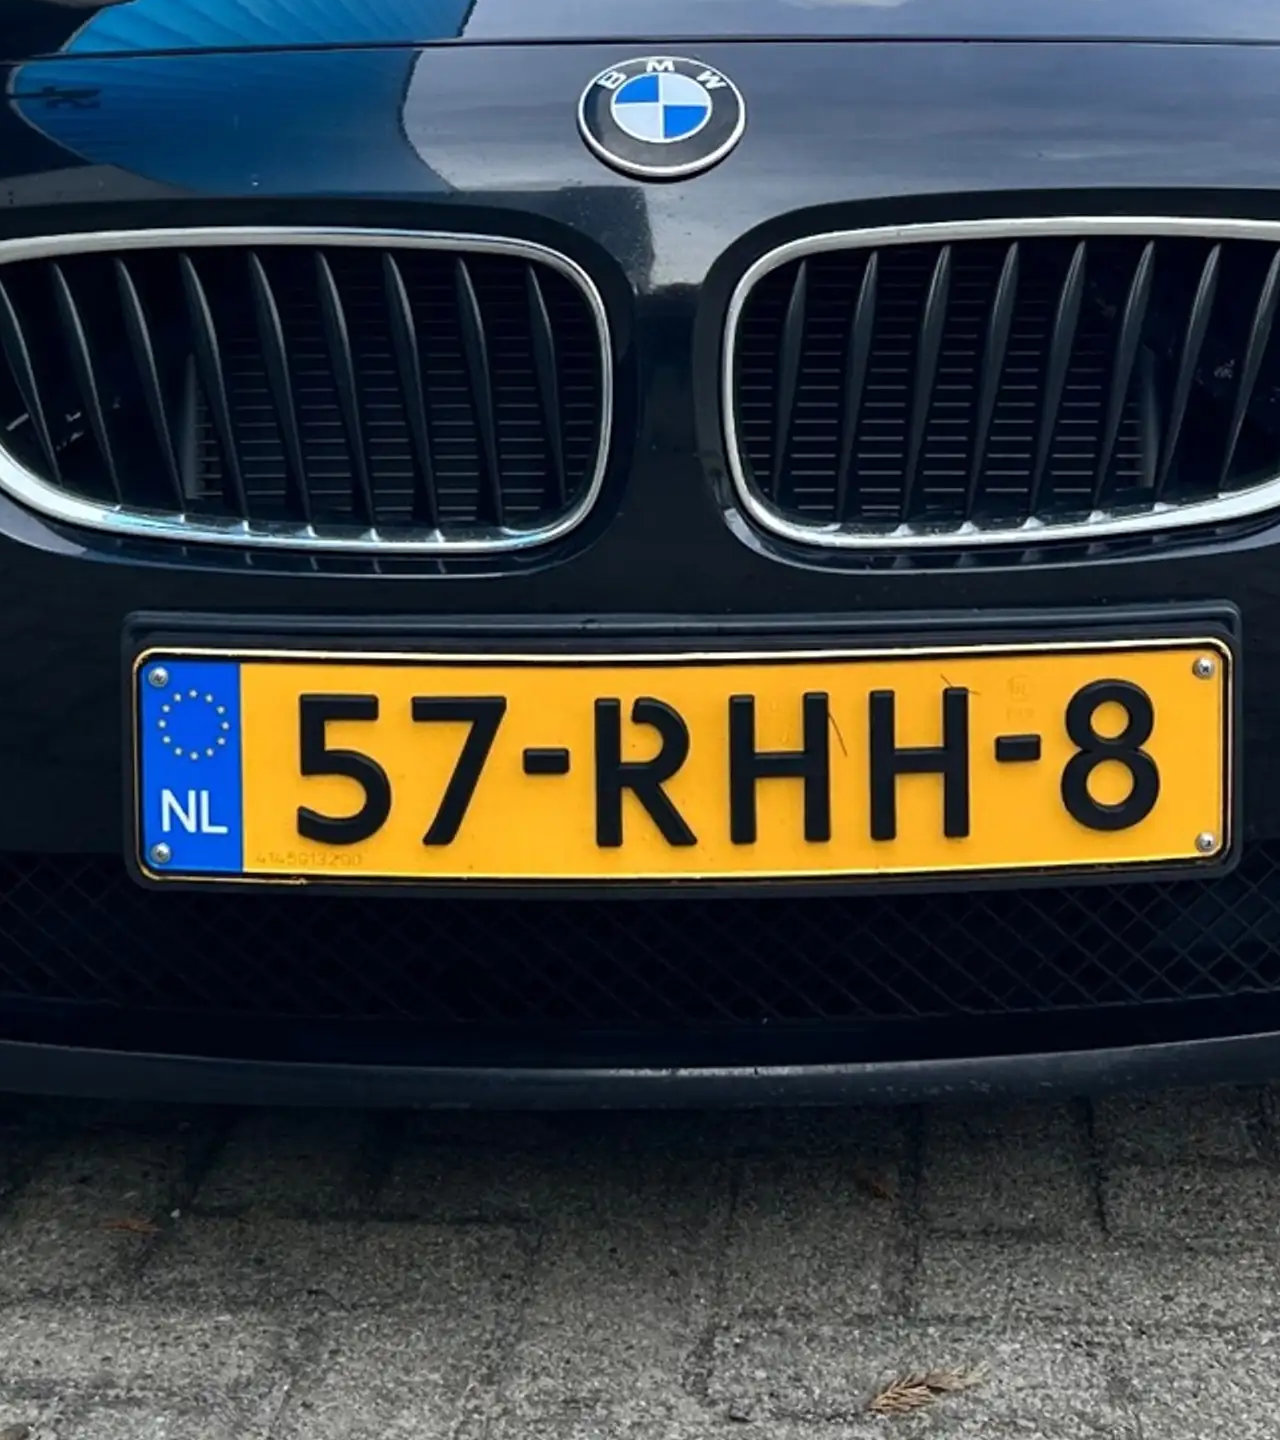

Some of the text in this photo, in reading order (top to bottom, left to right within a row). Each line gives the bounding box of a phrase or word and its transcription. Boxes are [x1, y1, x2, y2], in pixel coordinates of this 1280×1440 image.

[597, 59, 727, 90] BMW
[297, 678, 1160, 848] 57-RHH-8
[162, 789, 228, 834] NL
